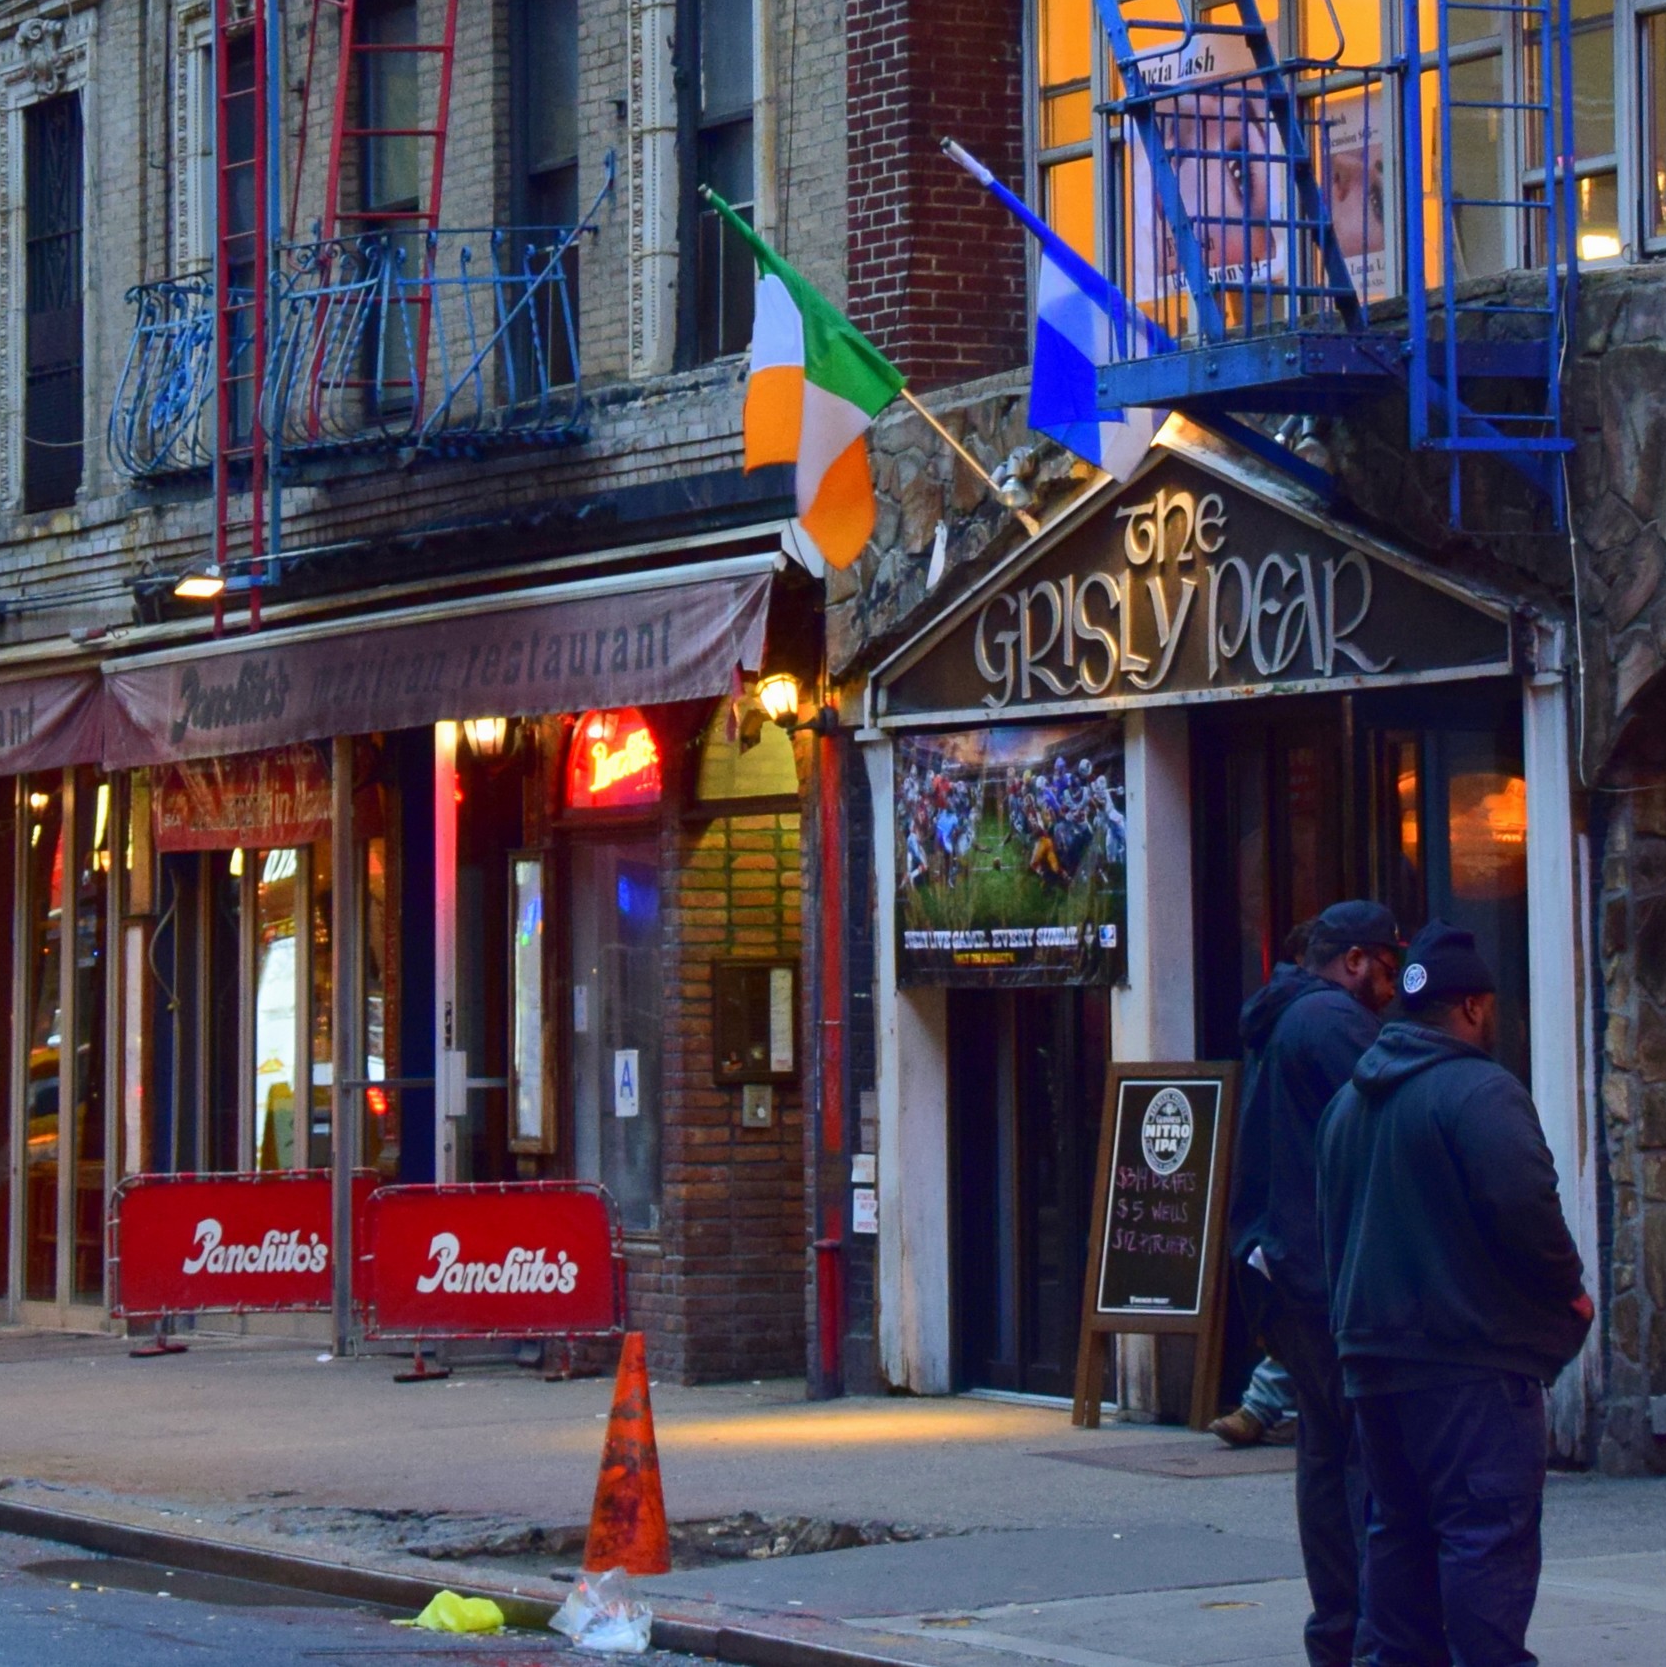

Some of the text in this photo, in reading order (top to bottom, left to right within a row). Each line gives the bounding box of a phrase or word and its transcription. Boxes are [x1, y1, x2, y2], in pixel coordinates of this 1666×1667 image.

[974, 549, 1395, 709] GRISLY PEAR
[309, 648, 445, 706] mexican
[460, 609, 673, 688] restaurant
[619, 1058, 635, 1098] A
[1144, 1123, 1190, 1138] NITRO
[1154, 1138, 1177, 1153] IPA
[1151, 1201, 1189, 1224] WELLS
[181, 1217, 329, 1275] Panchito's
[416, 1231, 579, 1294] Panchito's
